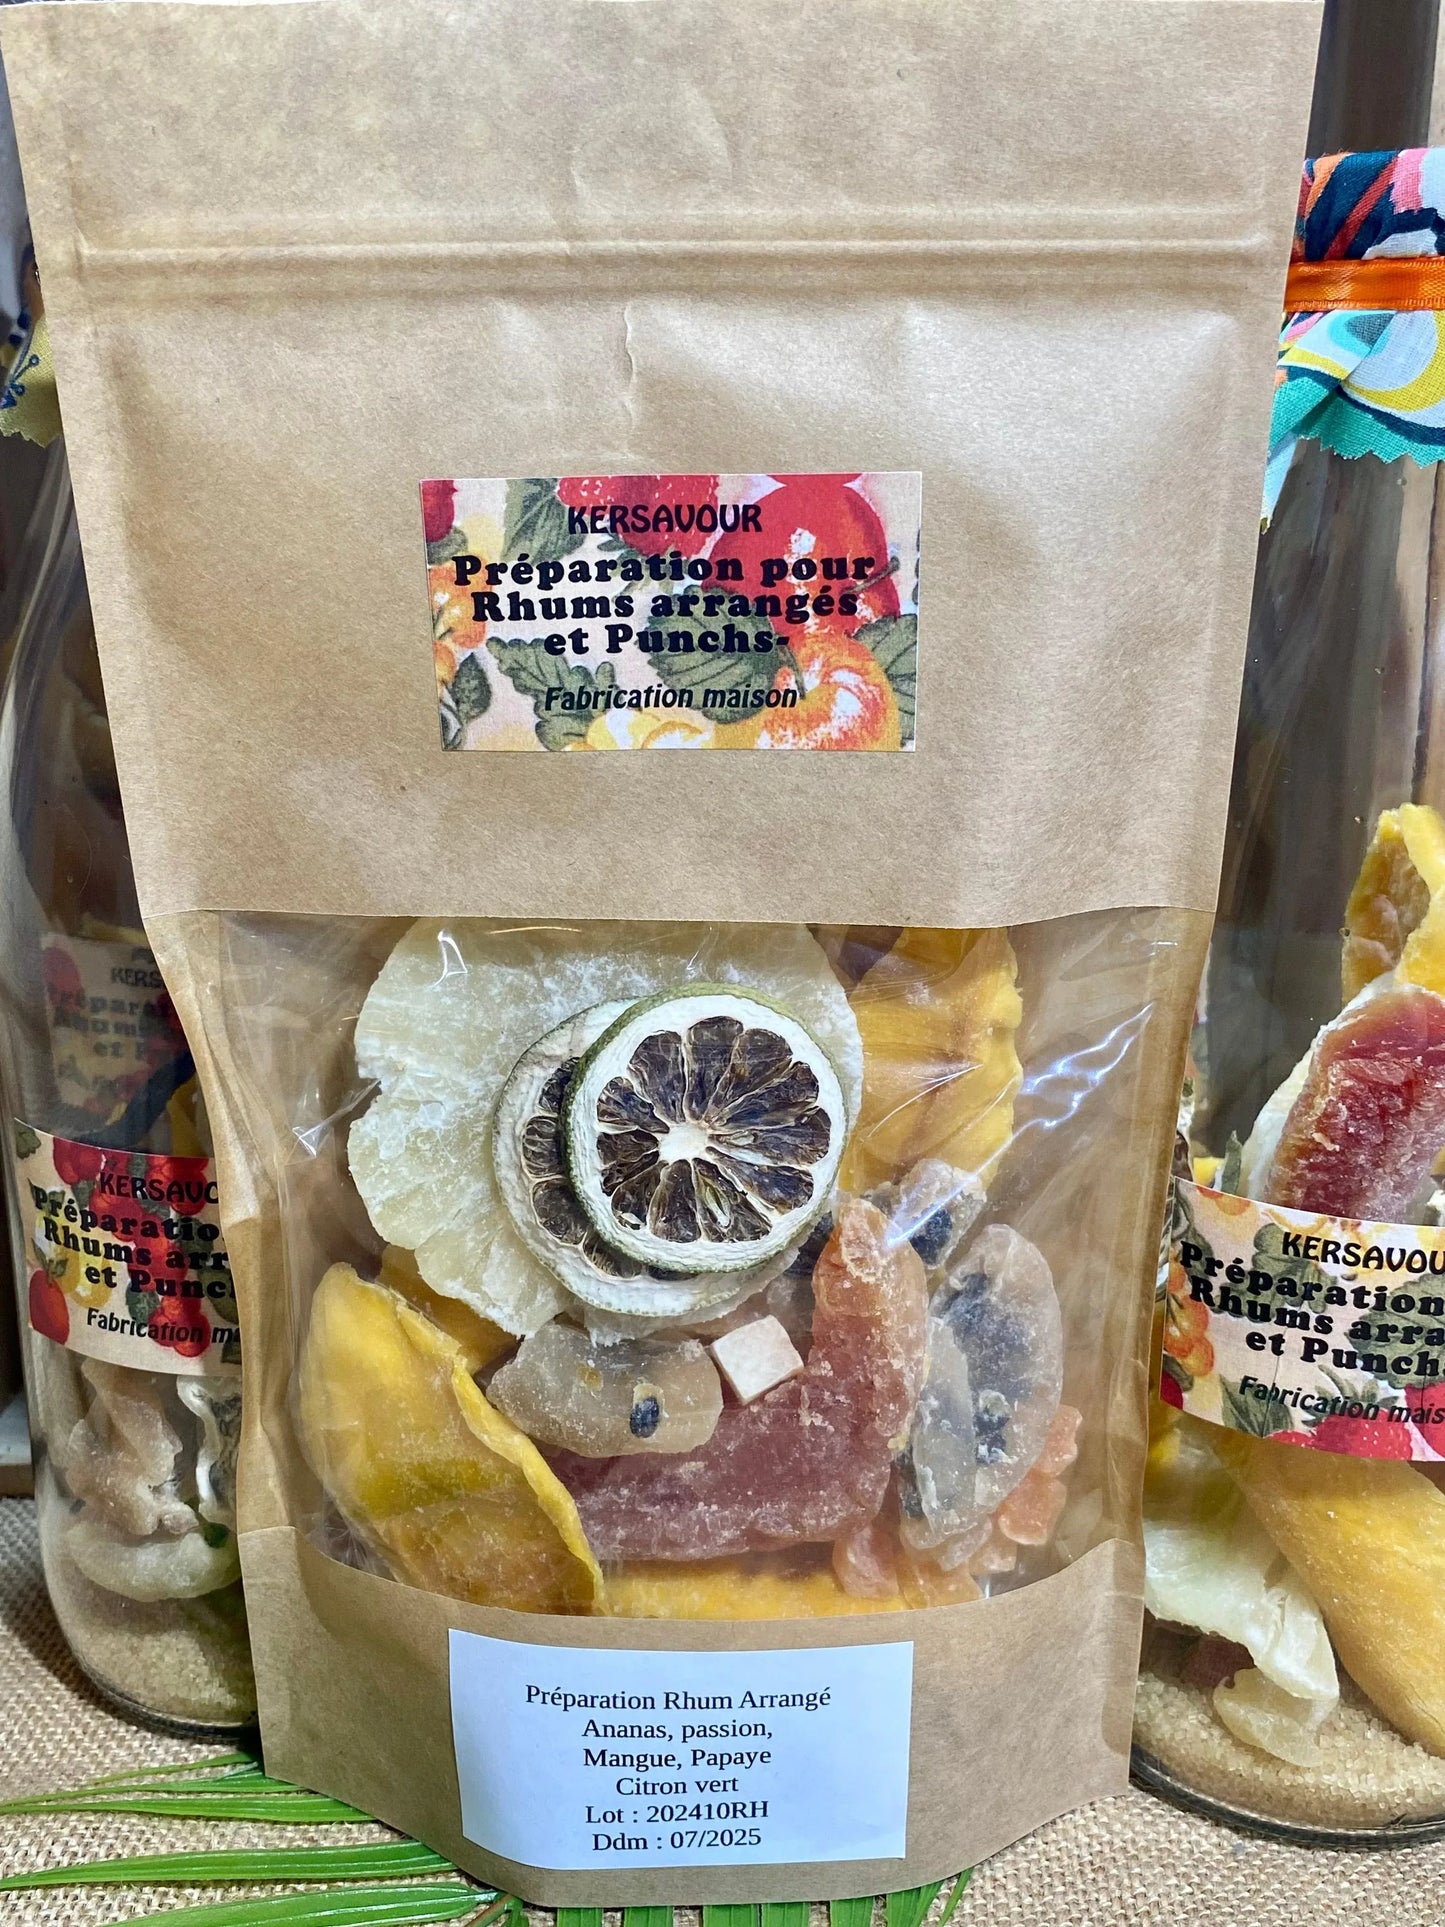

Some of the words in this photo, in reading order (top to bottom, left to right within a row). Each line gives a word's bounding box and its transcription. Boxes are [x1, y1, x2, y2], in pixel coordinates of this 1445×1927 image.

[568, 504, 762, 534] KERSAVOUR
[452, 552, 745, 591] Préparation
[760, 557, 873, 588] pour
[472, 592, 634, 623] Rhums
[651, 587, 858, 625] arrangés
[544, 627, 589, 655] et
[605, 624, 789, 655] Punchs-
[544, 684, 693, 711] Fabrication
[702, 687, 797, 709] maison
[33, 1185, 224, 1241] Préparatio
[44, 1216, 152, 1267] Rhums
[85, 1263, 117, 1289] et
[1180, 1241, 1443, 1316] Préparation
[1190, 1275, 1334, 1334] Rhums
[87, 1308, 204, 1343] Fabrication
[1246, 1331, 1285, 1356] et
[1300, 1336, 1445, 1377] Punch
[1240, 1375, 1379, 1420] Fabrication
[526, 1684, 655, 1713] Préparation
[664, 1691, 733, 1710] Rhum
[739, 1687, 831, 1712] Arrangé
[582, 1719, 674, 1743] Ananas,
[681, 1719, 773, 1743] passion,
[583, 1748, 682, 1772] Mangue,
[691, 1749, 772, 1770] Papaye
[616, 1777, 687, 1796] Citron
[696, 1777, 739, 1794] vert
[585, 1806, 624, 1824] Lot
[646, 1801, 769, 1823] 202410RH
[592, 1833, 648, 1851] Ddm
[670, 1828, 762, 1849] 07/2025
